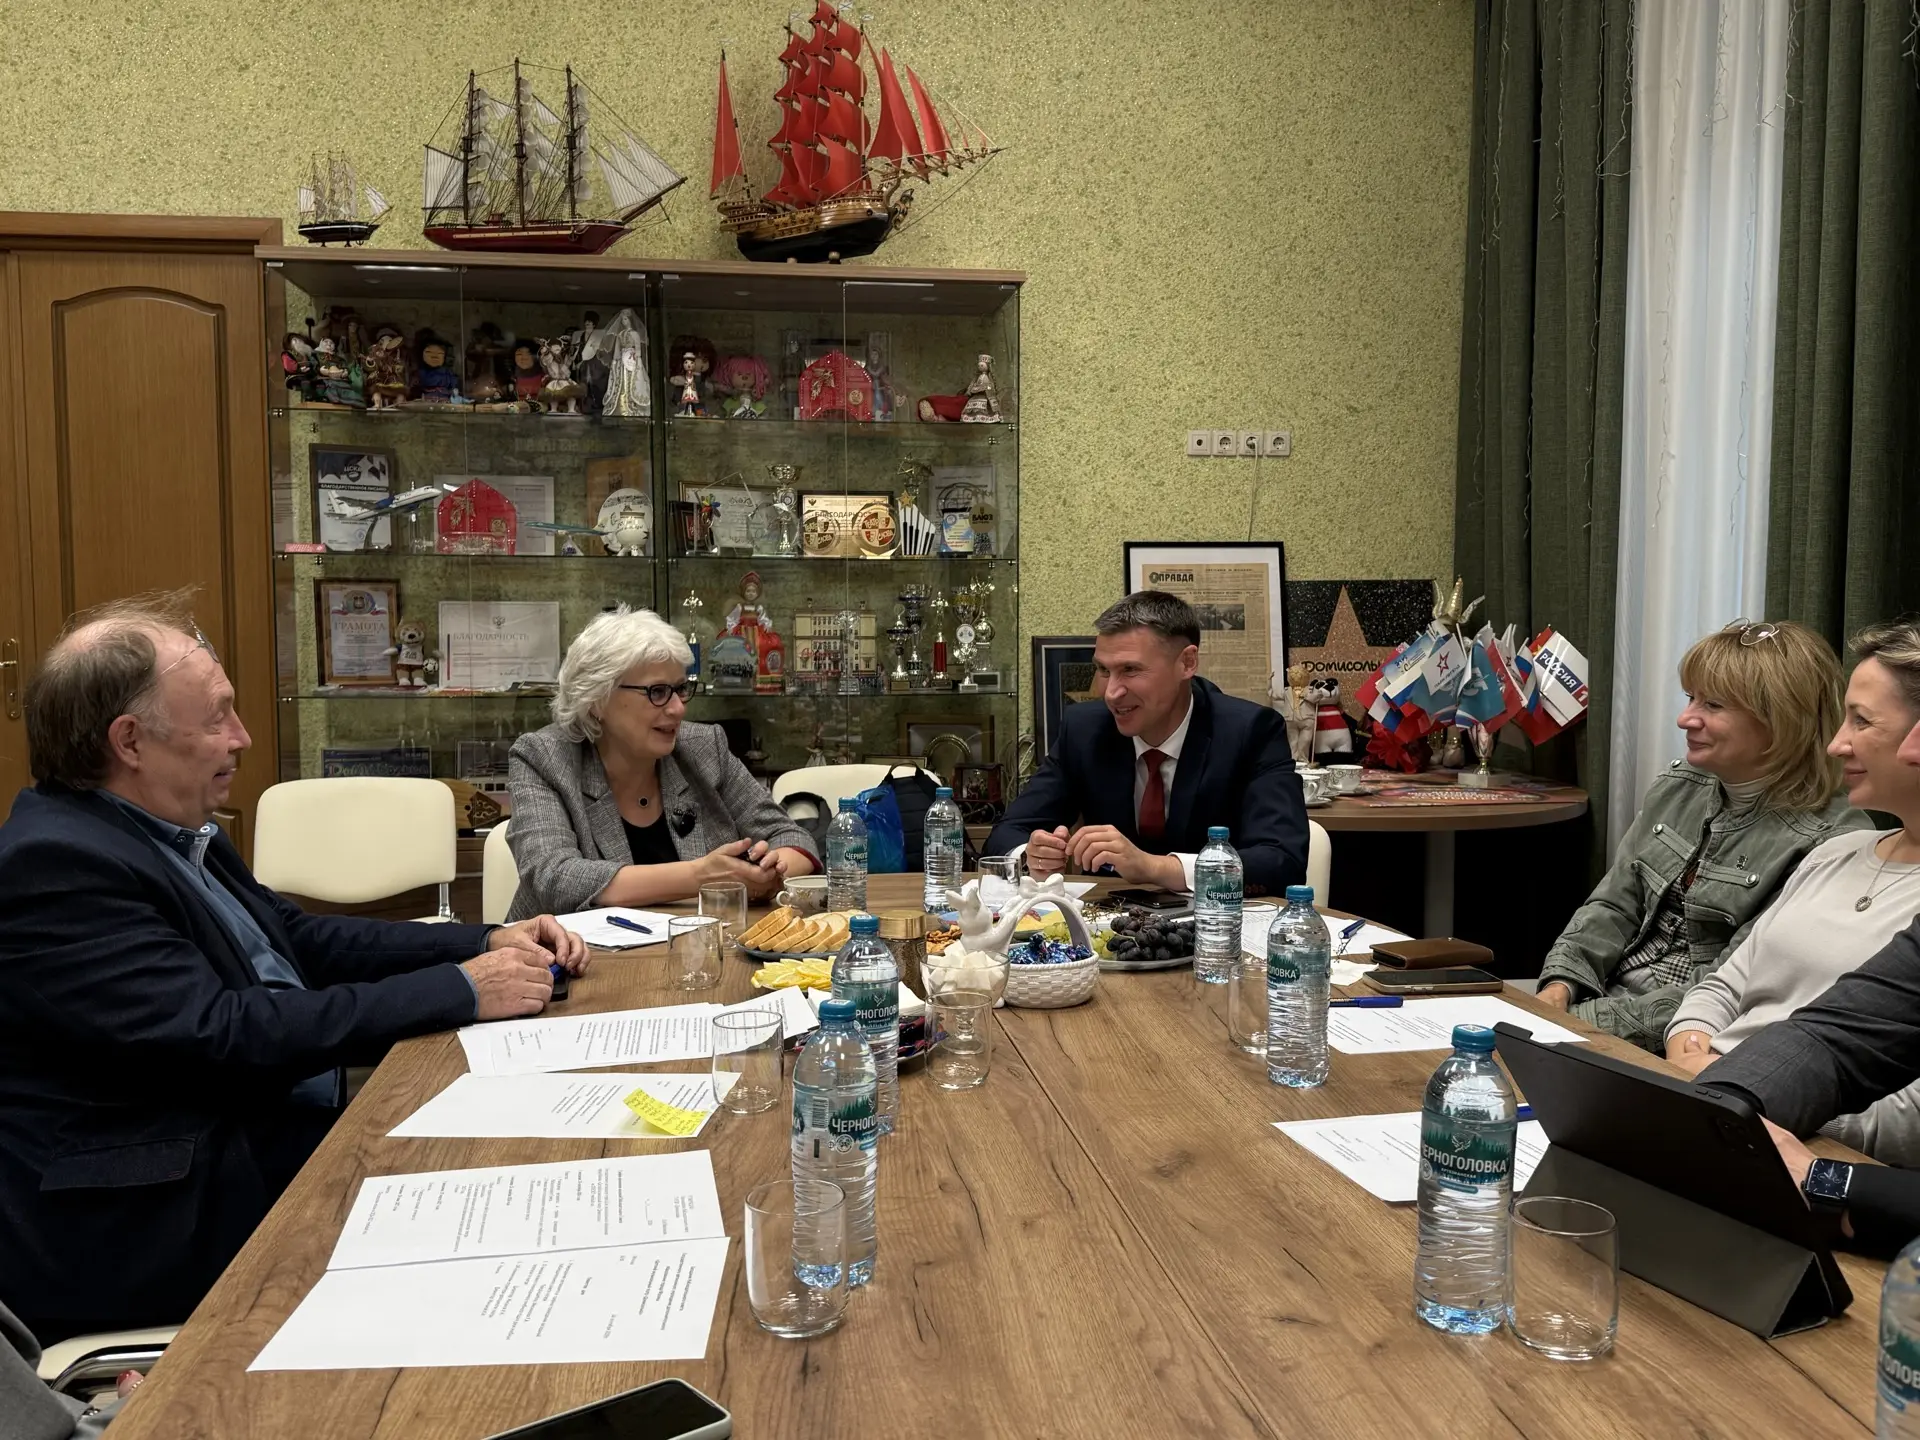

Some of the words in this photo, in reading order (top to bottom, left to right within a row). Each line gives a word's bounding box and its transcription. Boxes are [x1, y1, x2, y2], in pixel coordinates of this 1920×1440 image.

[1158, 573, 1194, 583] ПРАВДА
[334, 621, 386, 631] ГРАМОТА
[1301, 660, 1381, 673] ДОМИСОЛЬ
[1539, 652, 1577, 688] РОССИЯ
